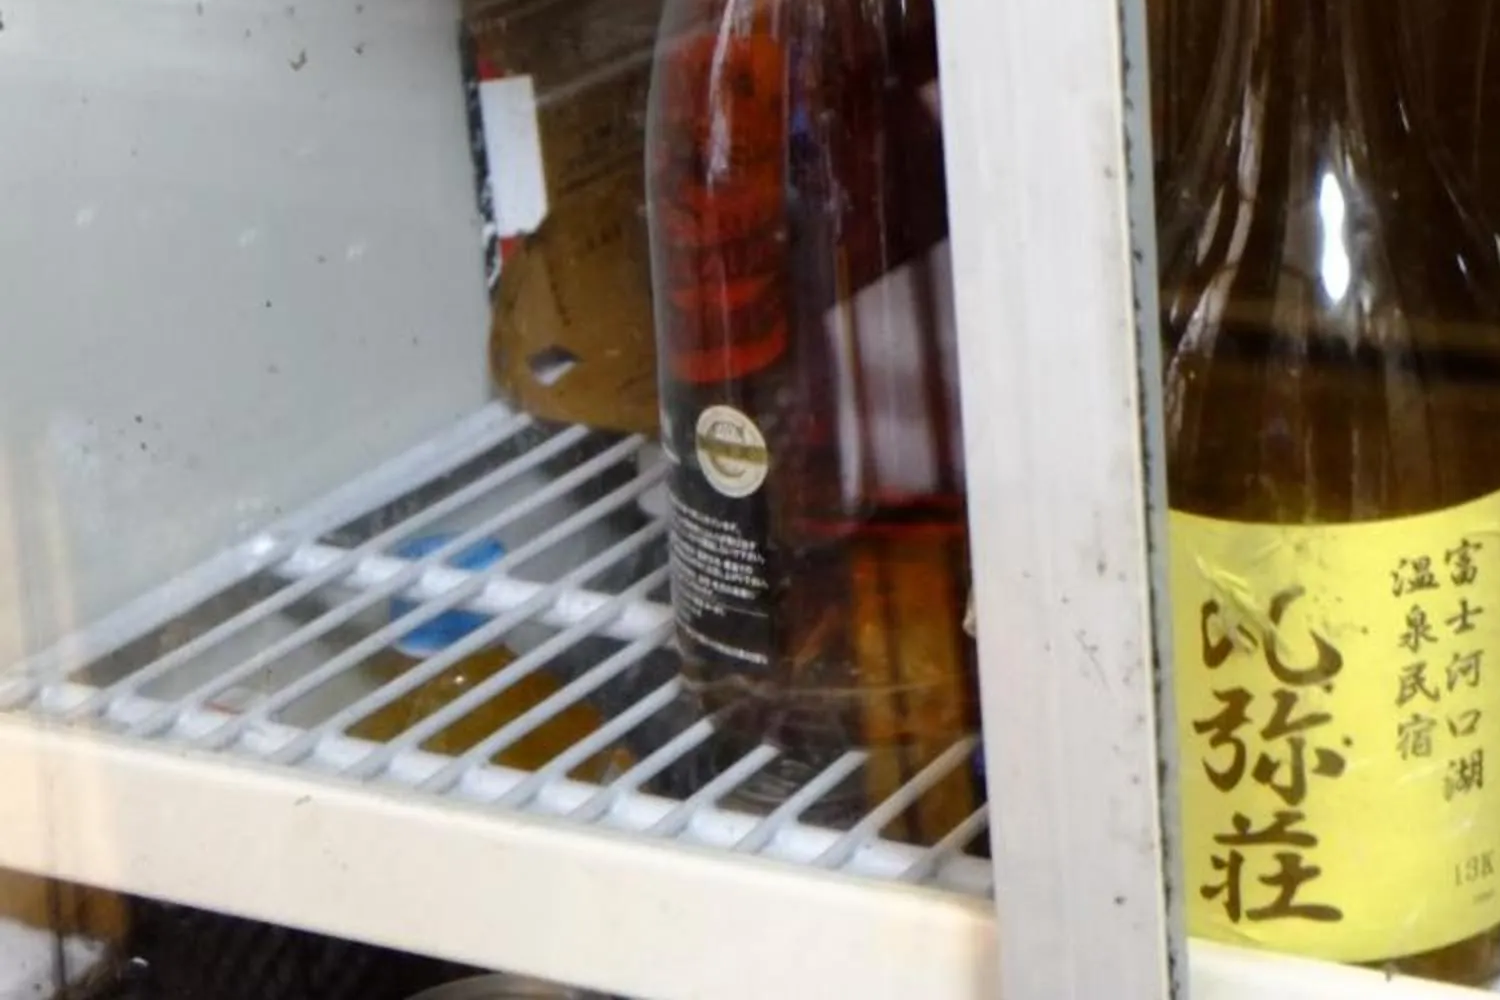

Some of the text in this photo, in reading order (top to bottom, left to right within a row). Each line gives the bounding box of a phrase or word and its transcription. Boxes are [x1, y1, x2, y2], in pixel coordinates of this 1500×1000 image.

[1390, 557, 1441, 762] 温泉民宿
[1443, 537, 1485, 803] 富士河口湖
